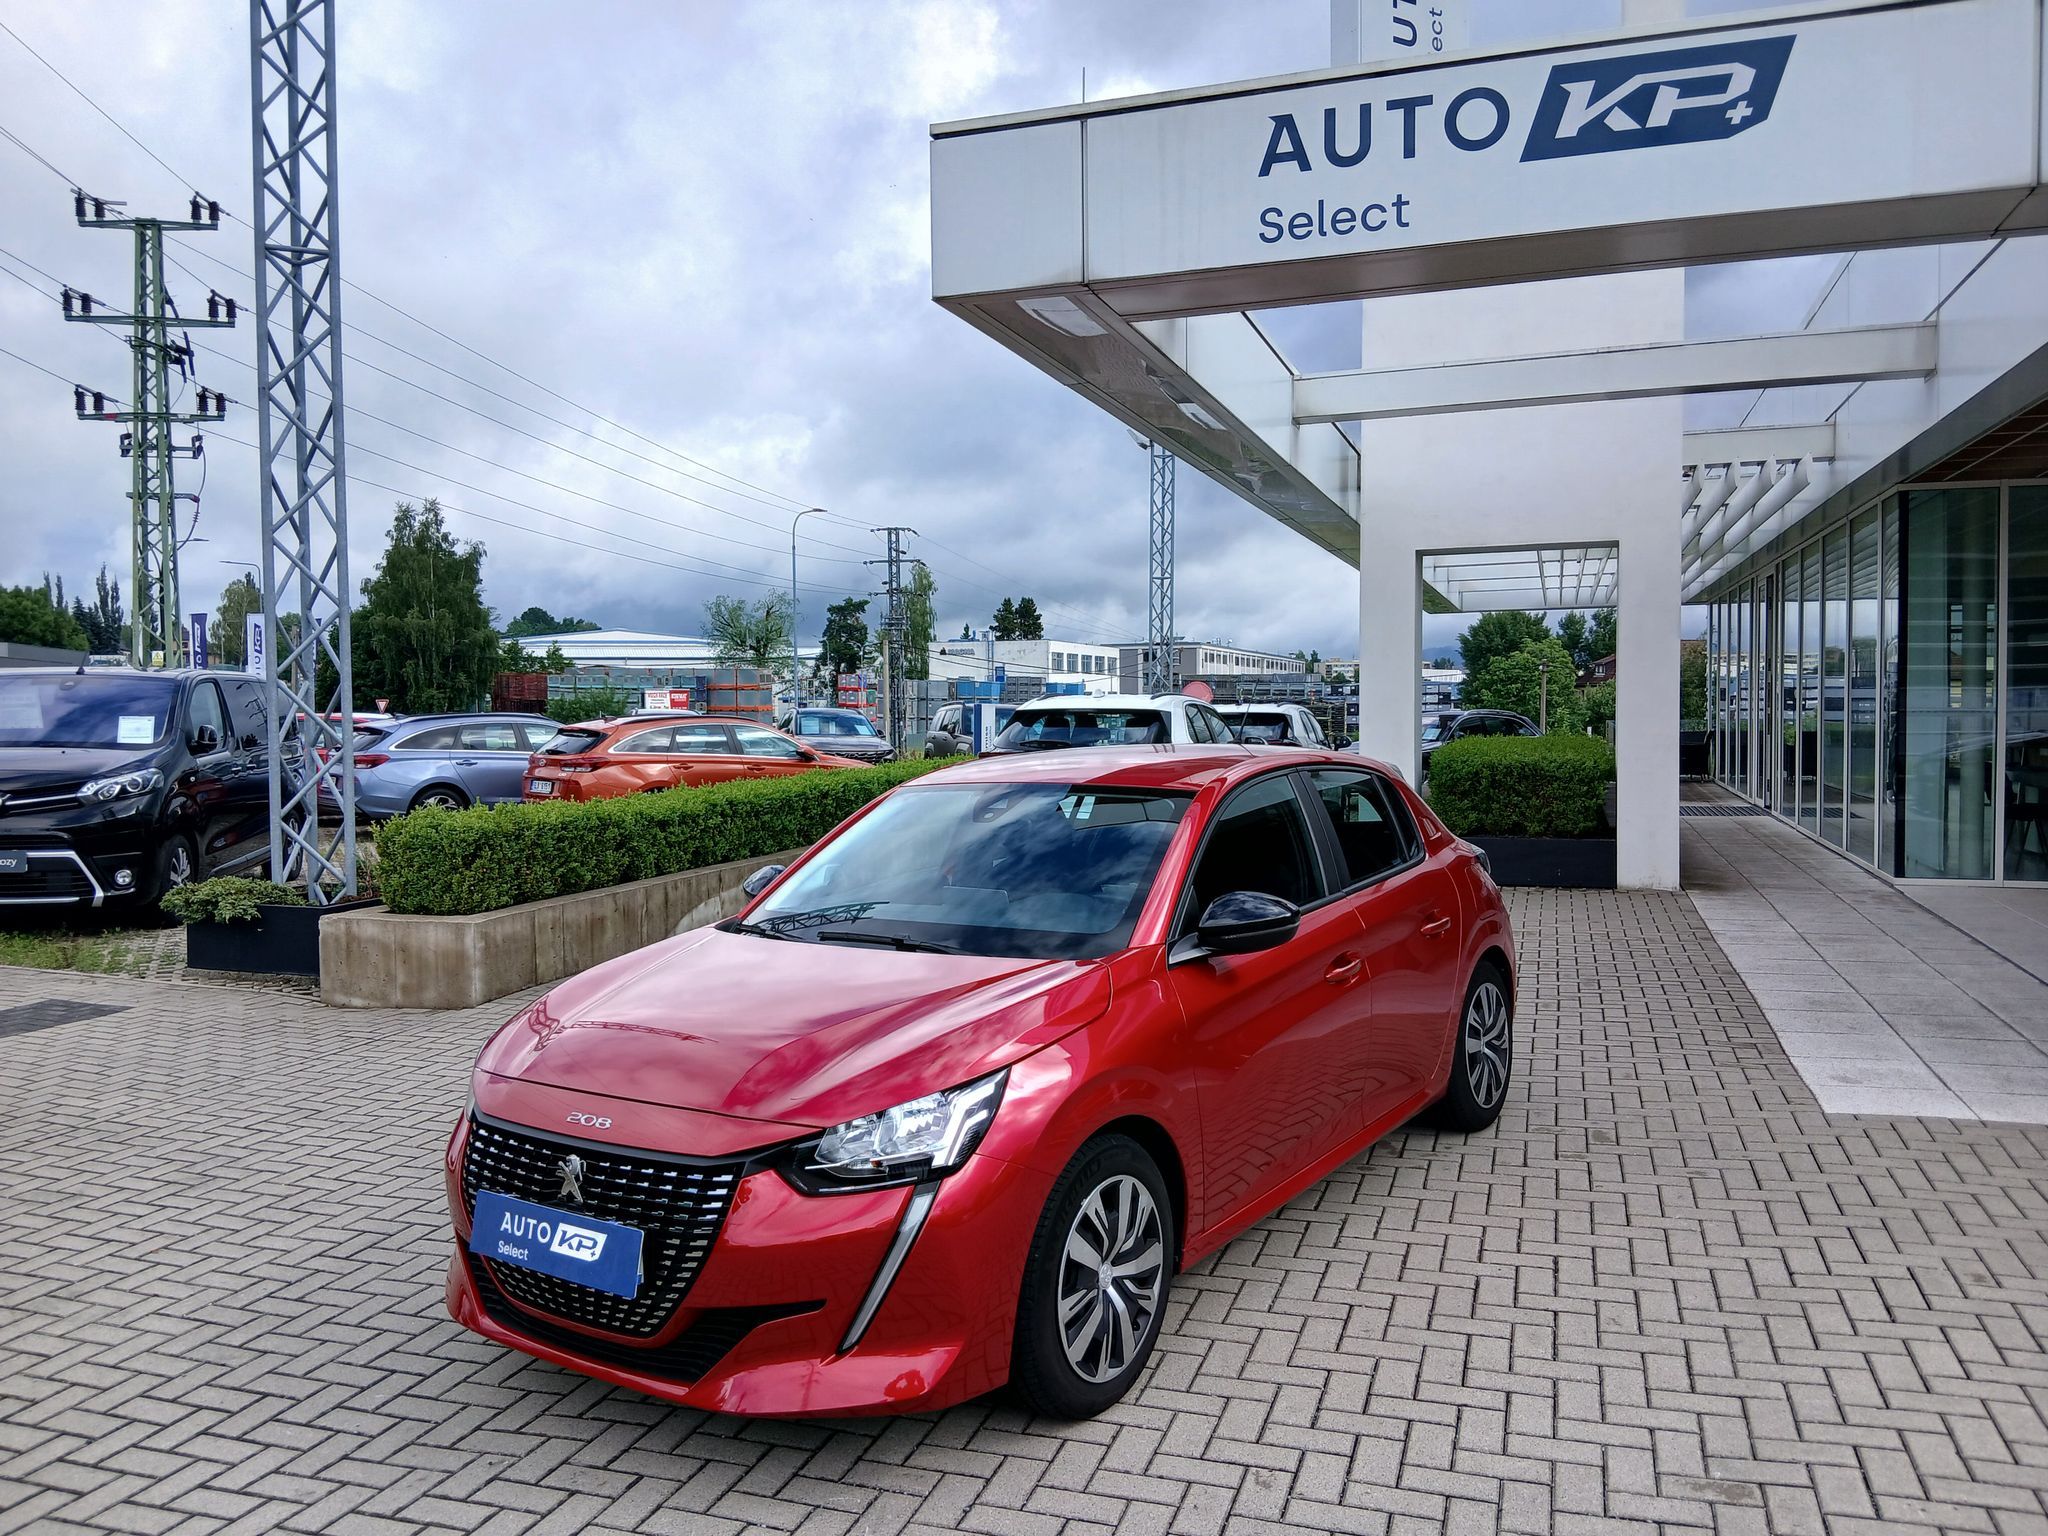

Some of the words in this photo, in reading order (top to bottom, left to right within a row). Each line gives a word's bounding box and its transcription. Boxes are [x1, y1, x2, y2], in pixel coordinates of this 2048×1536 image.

[1258, 87, 1510, 178] AUTO
[1259, 194, 1410, 244] Select
[566, 1111, 612, 1129] 208
[500, 1211, 552, 1244] AUTO
[497, 1240, 529, 1261] Select
